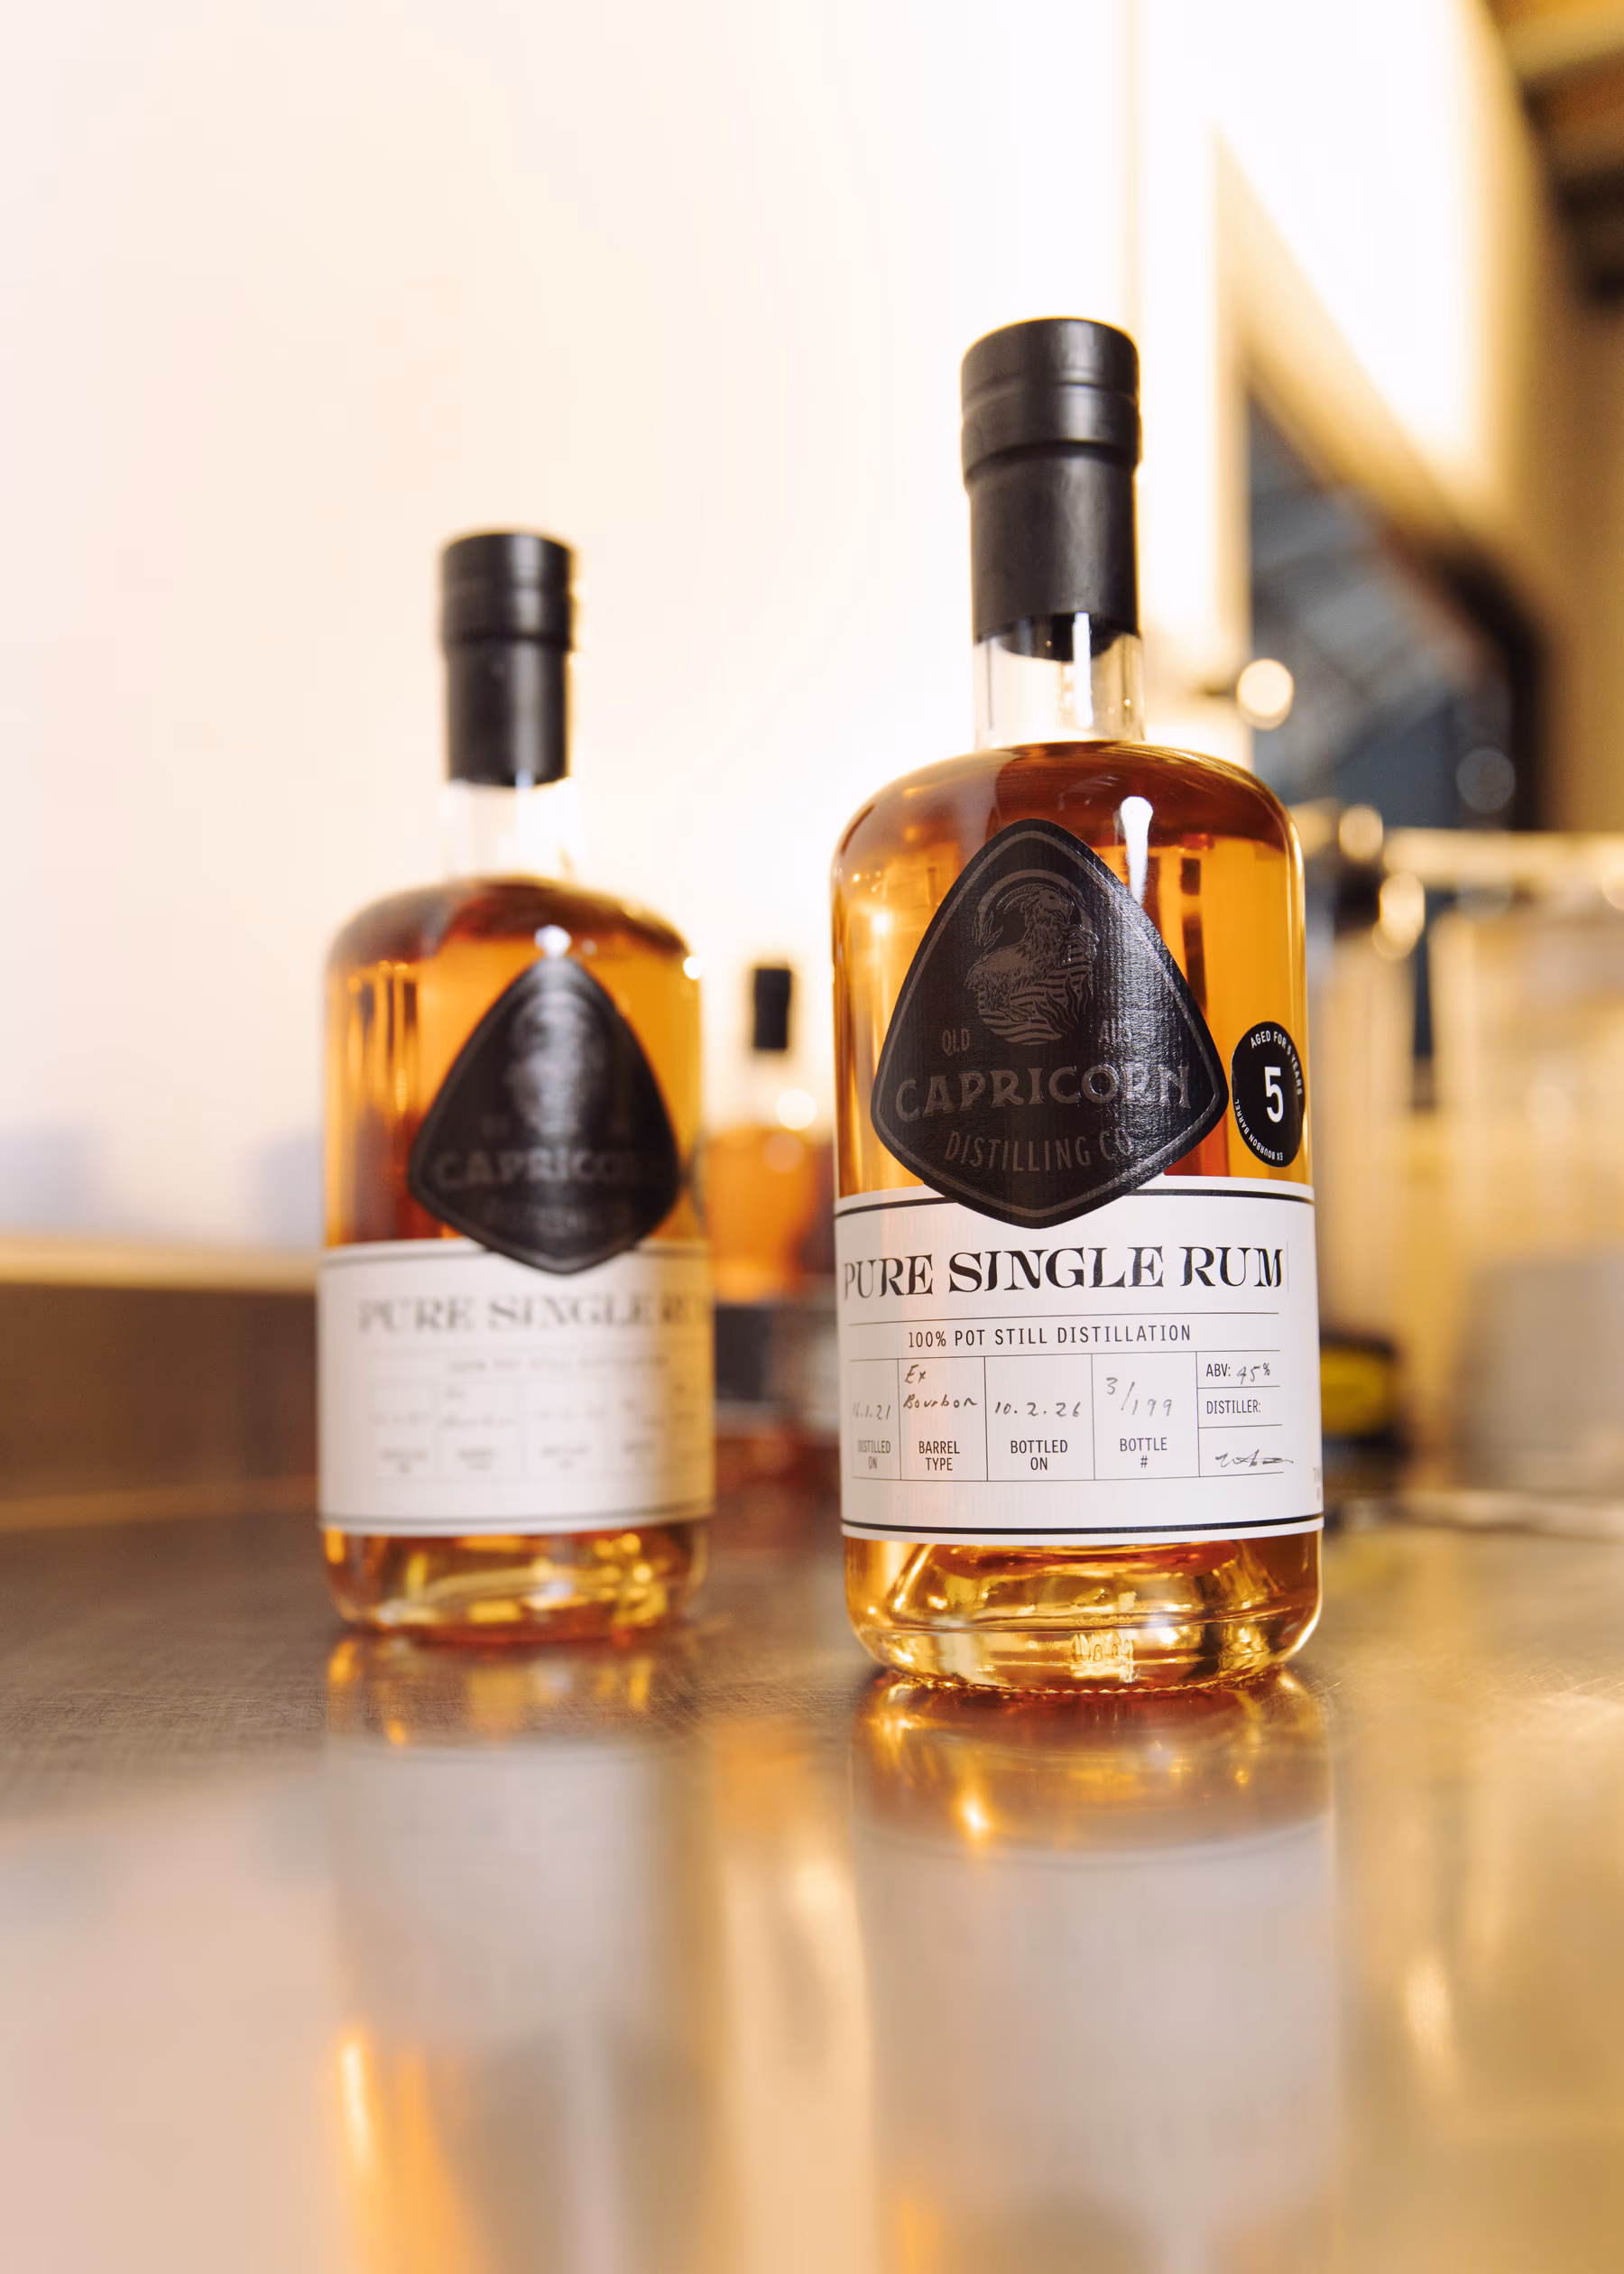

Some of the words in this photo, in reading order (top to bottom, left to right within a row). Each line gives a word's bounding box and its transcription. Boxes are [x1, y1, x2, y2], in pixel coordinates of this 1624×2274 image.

[942, 1027, 970, 1056] QLD
[1250, 1030, 1271, 1049] AGED
[1273, 1031, 1287, 1050] FOR
[1291, 1054, 1303, 1095] YEARS
[895, 1062, 1191, 1123] CAPRICORN
[1264, 1066, 1284, 1123] 5
[1234, 1098, 1250, 1134] BARREL
[944, 1130, 1091, 1171] DISTILLING
[1249, 1133, 1276, 1160] BOURBON
[1276, 1151, 1284, 1161] EX
[844, 1253, 934, 1301] PURE
[948, 1245, 1164, 1293] SINGLE
[1179, 1246, 1284, 1288] RUM
[359, 1297, 475, 1334] PURE
[487, 1292, 652, 1330] SINGLE
[909, 1330, 946, 1348] 100%
[955, 1328, 986, 1346] POT
[994, 1326, 1047, 1345] STILL
[1057, 1324, 1191, 1344] DISTILLATION
[1205, 1363, 1231, 1378] ABV:
[902, 1393, 978, 1410] Bourbon
[1206, 1400, 1261, 1415] DISTILLER:
[857, 1439, 891, 1454] DISTILLED
[918, 1440, 961, 1456] BARREL
[1010, 1439, 1068, 1454] BOTTLED
[1120, 1437, 1168, 1452] BOTTLE
[868, 1456, 878, 1470] ON
[926, 1457, 954, 1472] TYPE
[1030, 1457, 1048, 1471] ON
[1140, 1455, 1149, 1469] #
